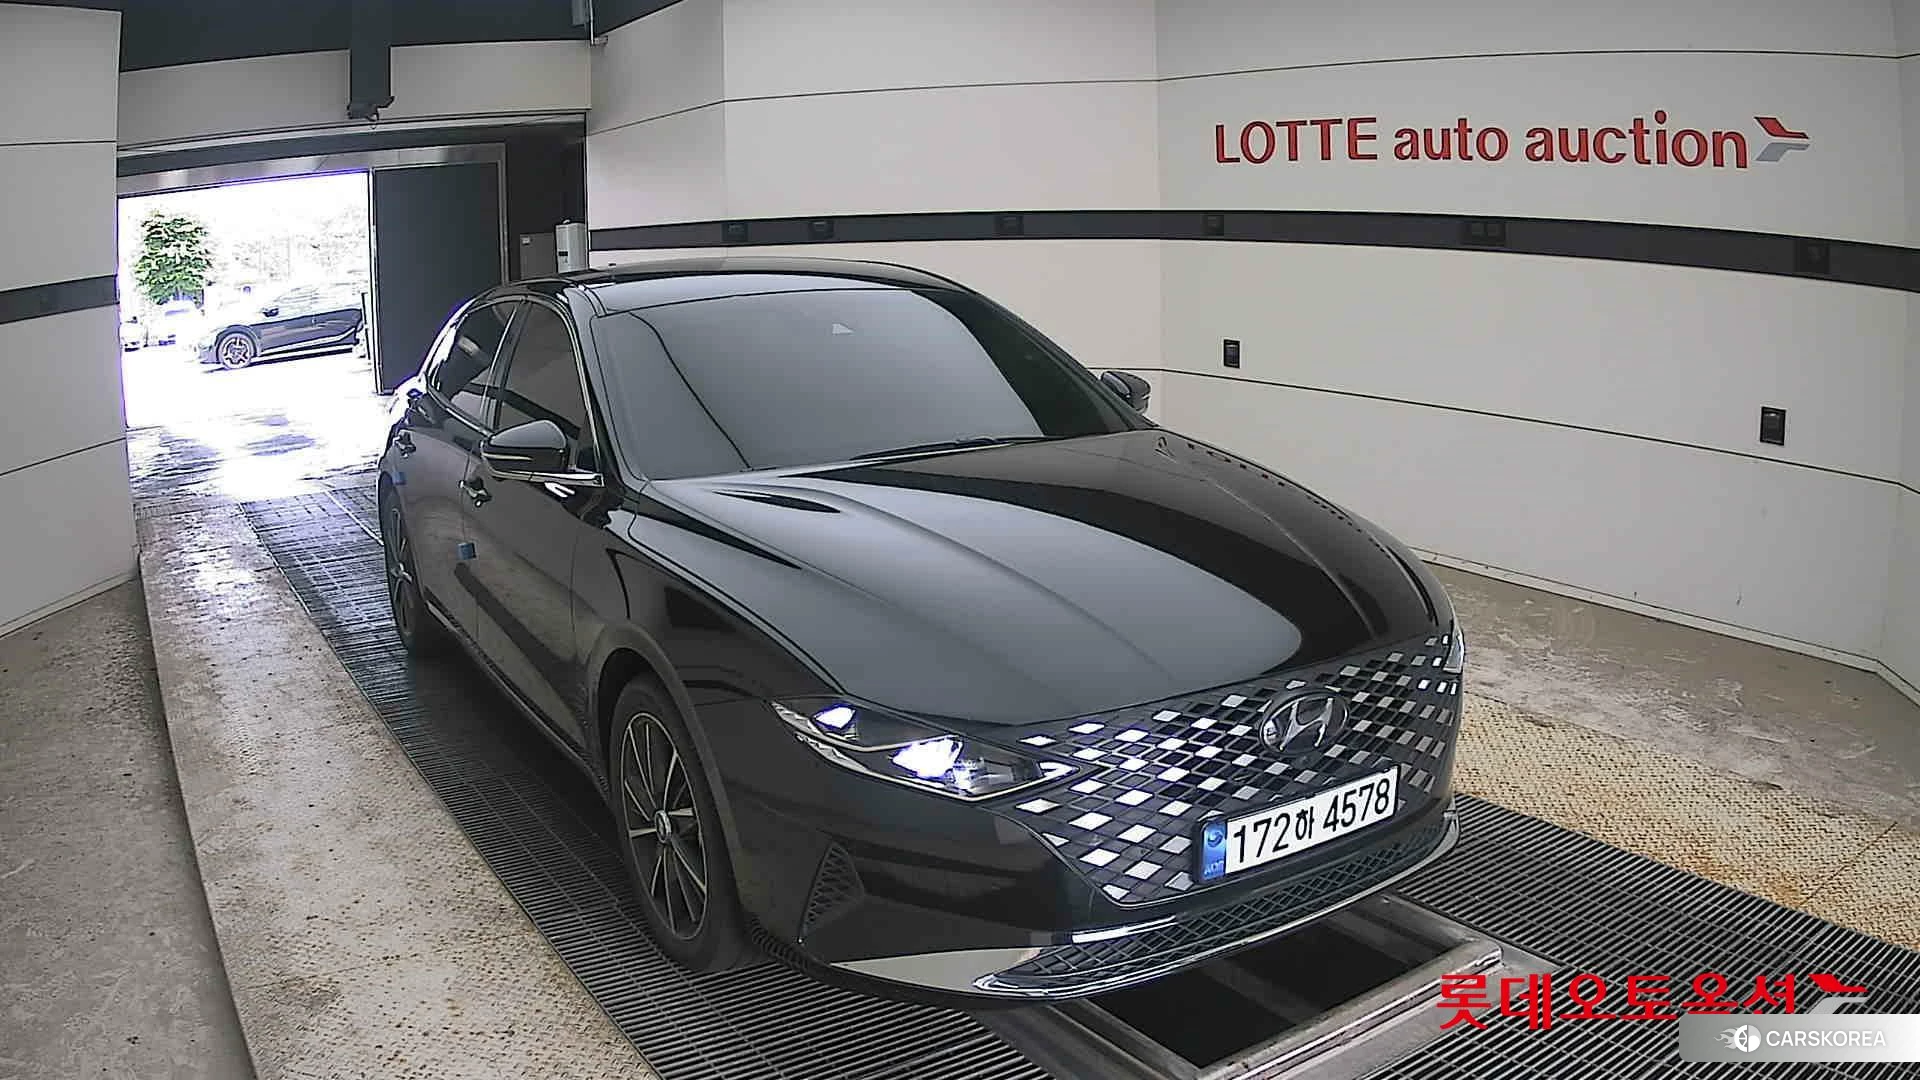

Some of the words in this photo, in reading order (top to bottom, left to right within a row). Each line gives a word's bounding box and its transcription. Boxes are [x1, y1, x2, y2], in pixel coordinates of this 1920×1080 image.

[1215, 116, 1379, 165] LOTTE
[1394, 117, 1509, 162] auto
[1525, 109, 1749, 169] auction
[1232, 805, 1315, 864] 172하
[1322, 777, 1391, 833] 4578
